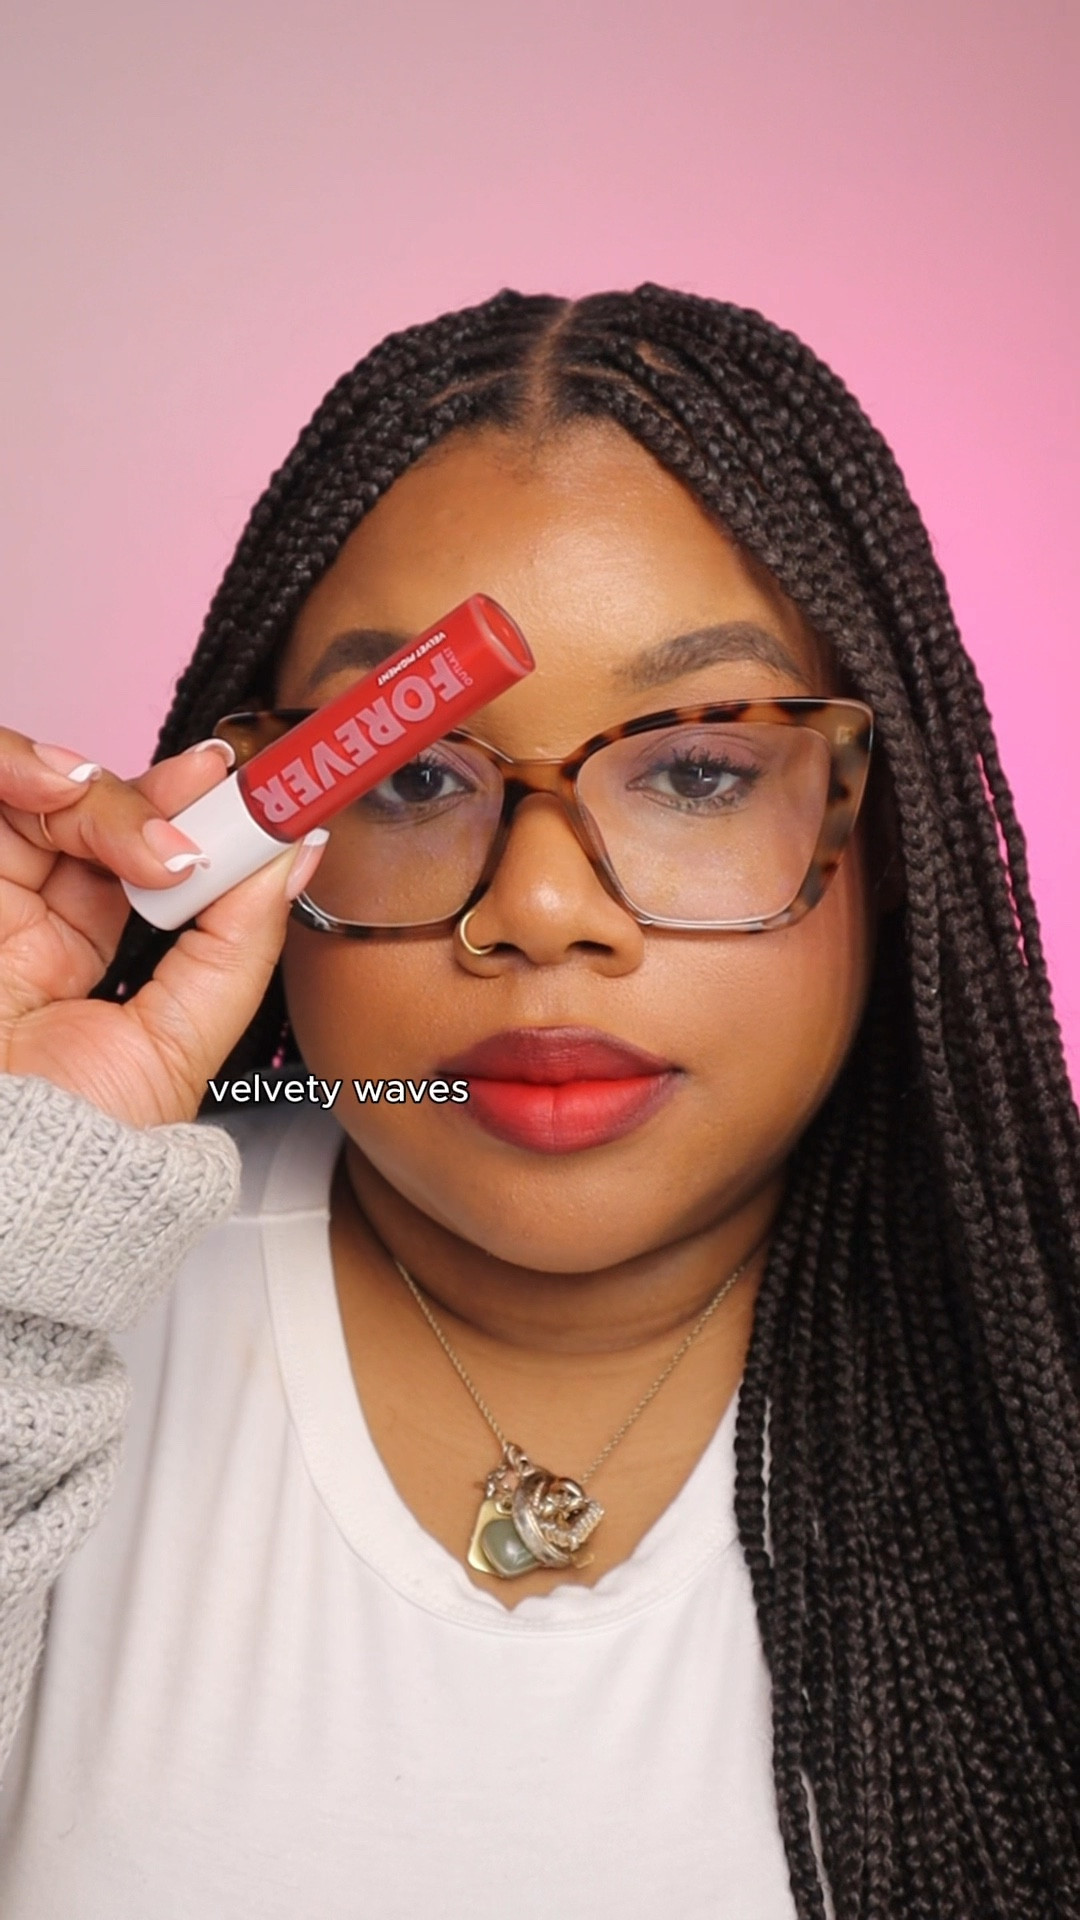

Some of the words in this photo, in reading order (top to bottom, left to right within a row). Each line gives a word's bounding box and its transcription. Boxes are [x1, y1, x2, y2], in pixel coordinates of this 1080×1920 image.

[416, 632, 446, 658] VELVET
[378, 652, 416, 686] PIGMENT
[443, 647, 473, 686] OUTLAST
[250, 651, 466, 823] FOREVER
